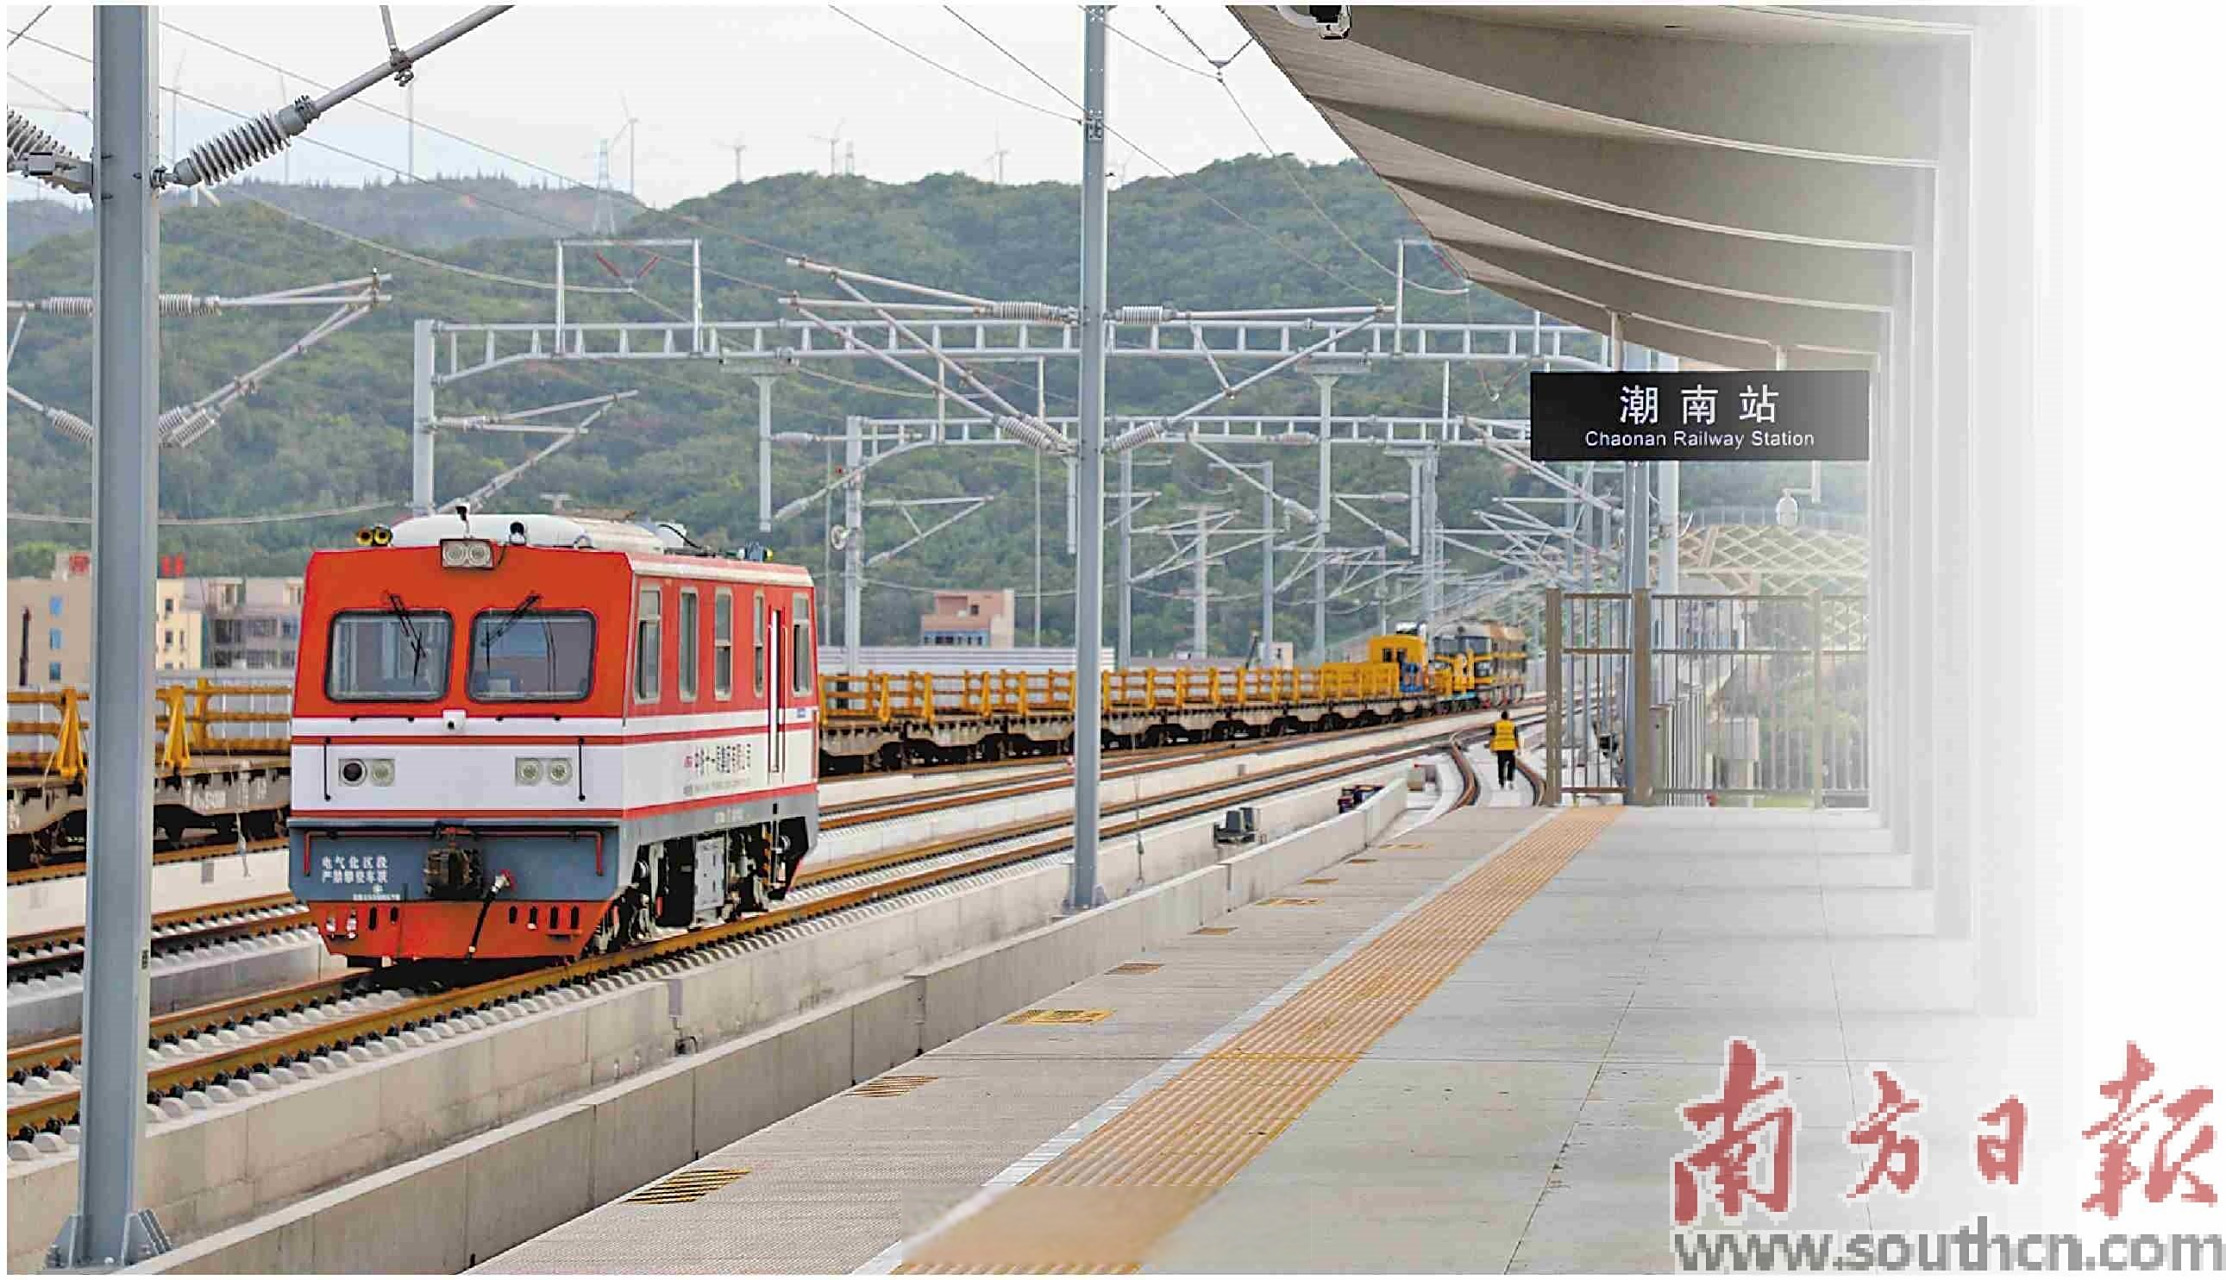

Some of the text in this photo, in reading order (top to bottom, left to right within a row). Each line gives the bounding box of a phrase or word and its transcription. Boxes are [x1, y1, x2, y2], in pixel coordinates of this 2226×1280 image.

[1619, 384, 1779, 425] 潮南站
[1585, 430, 1815, 451] Chaonan Railway Station
[321, 855, 389, 870] 电气化区段
